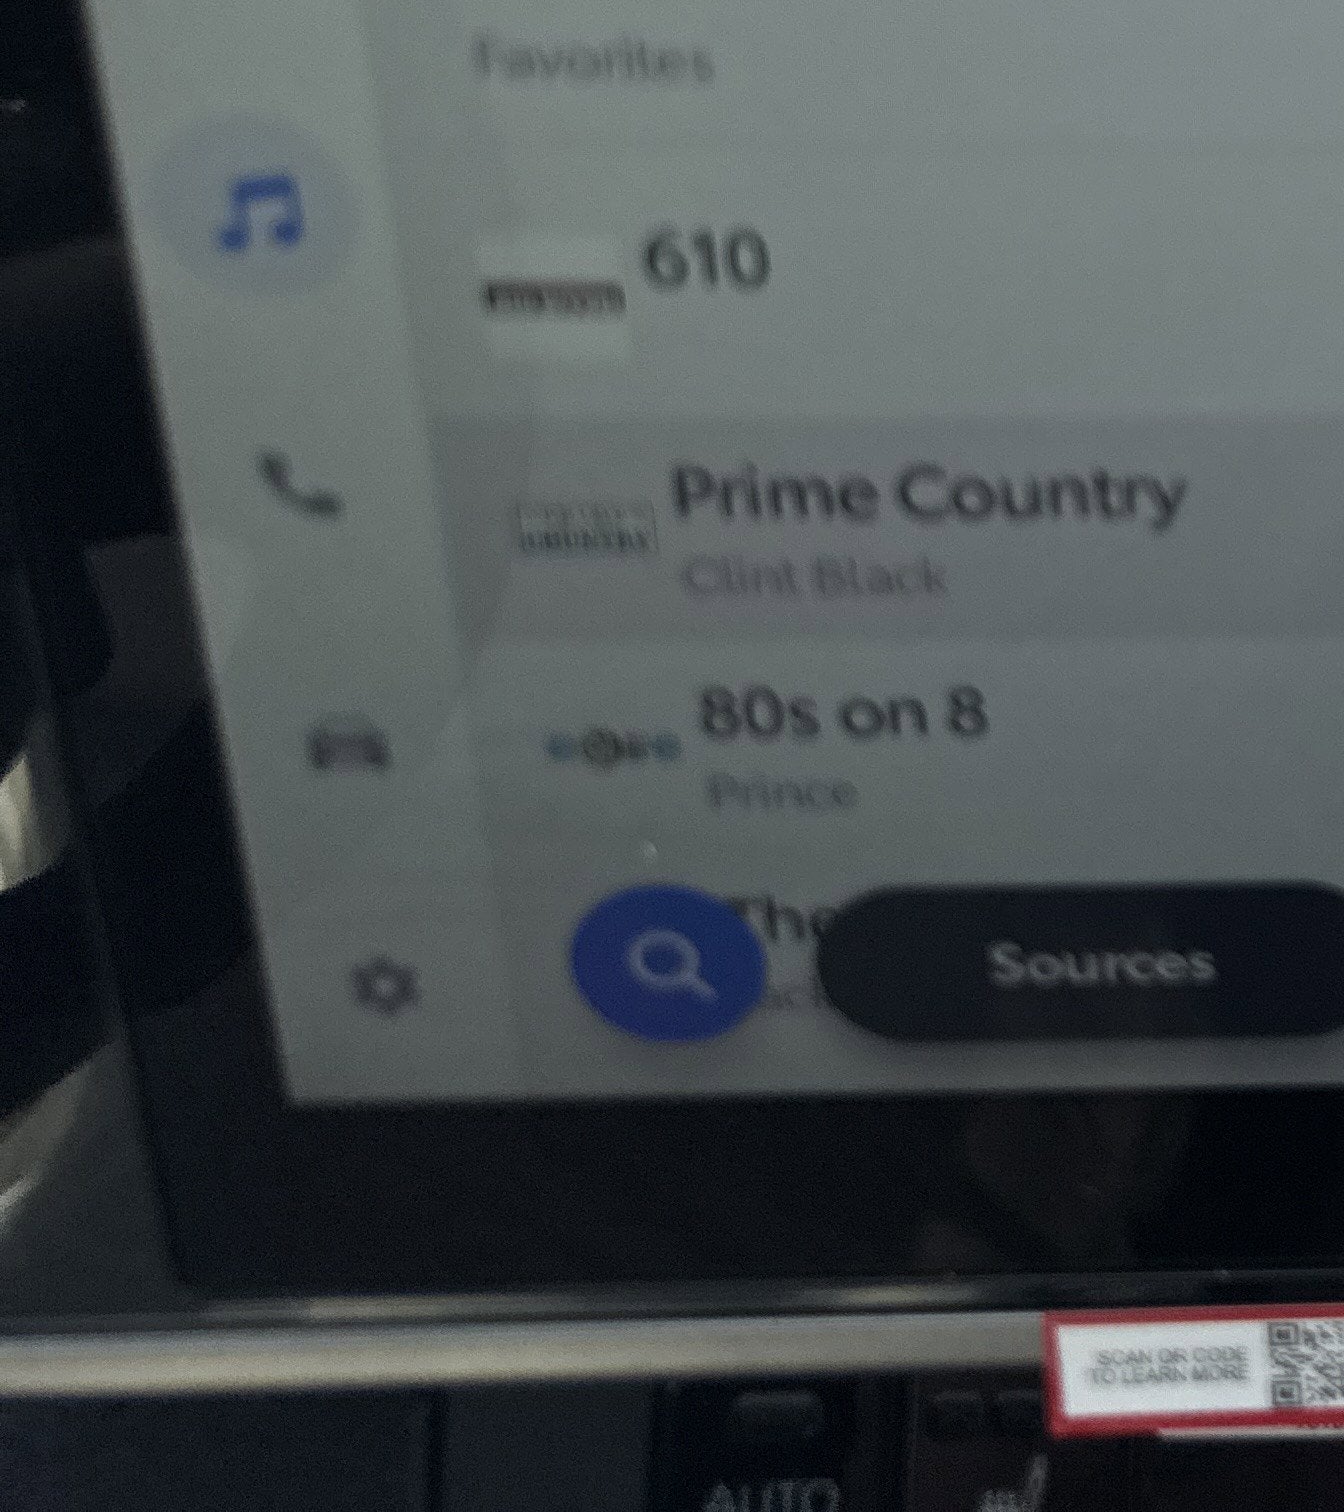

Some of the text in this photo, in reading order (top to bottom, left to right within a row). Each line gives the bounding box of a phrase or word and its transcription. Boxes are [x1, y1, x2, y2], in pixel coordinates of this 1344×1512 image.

[472, 33, 713, 84] Favorites
[643, 225, 772, 291] 610
[670, 462, 1187, 532] Prime Country
[684, 552, 948, 599] Clint Black
[699, 687, 989, 742] 80s on 8
[707, 770, 857, 814] Prince
[986, 942, 1217, 988] Sources
[1097, 1348, 1152, 1366] SCAN
[1193, 1345, 1248, 1363] CODE
